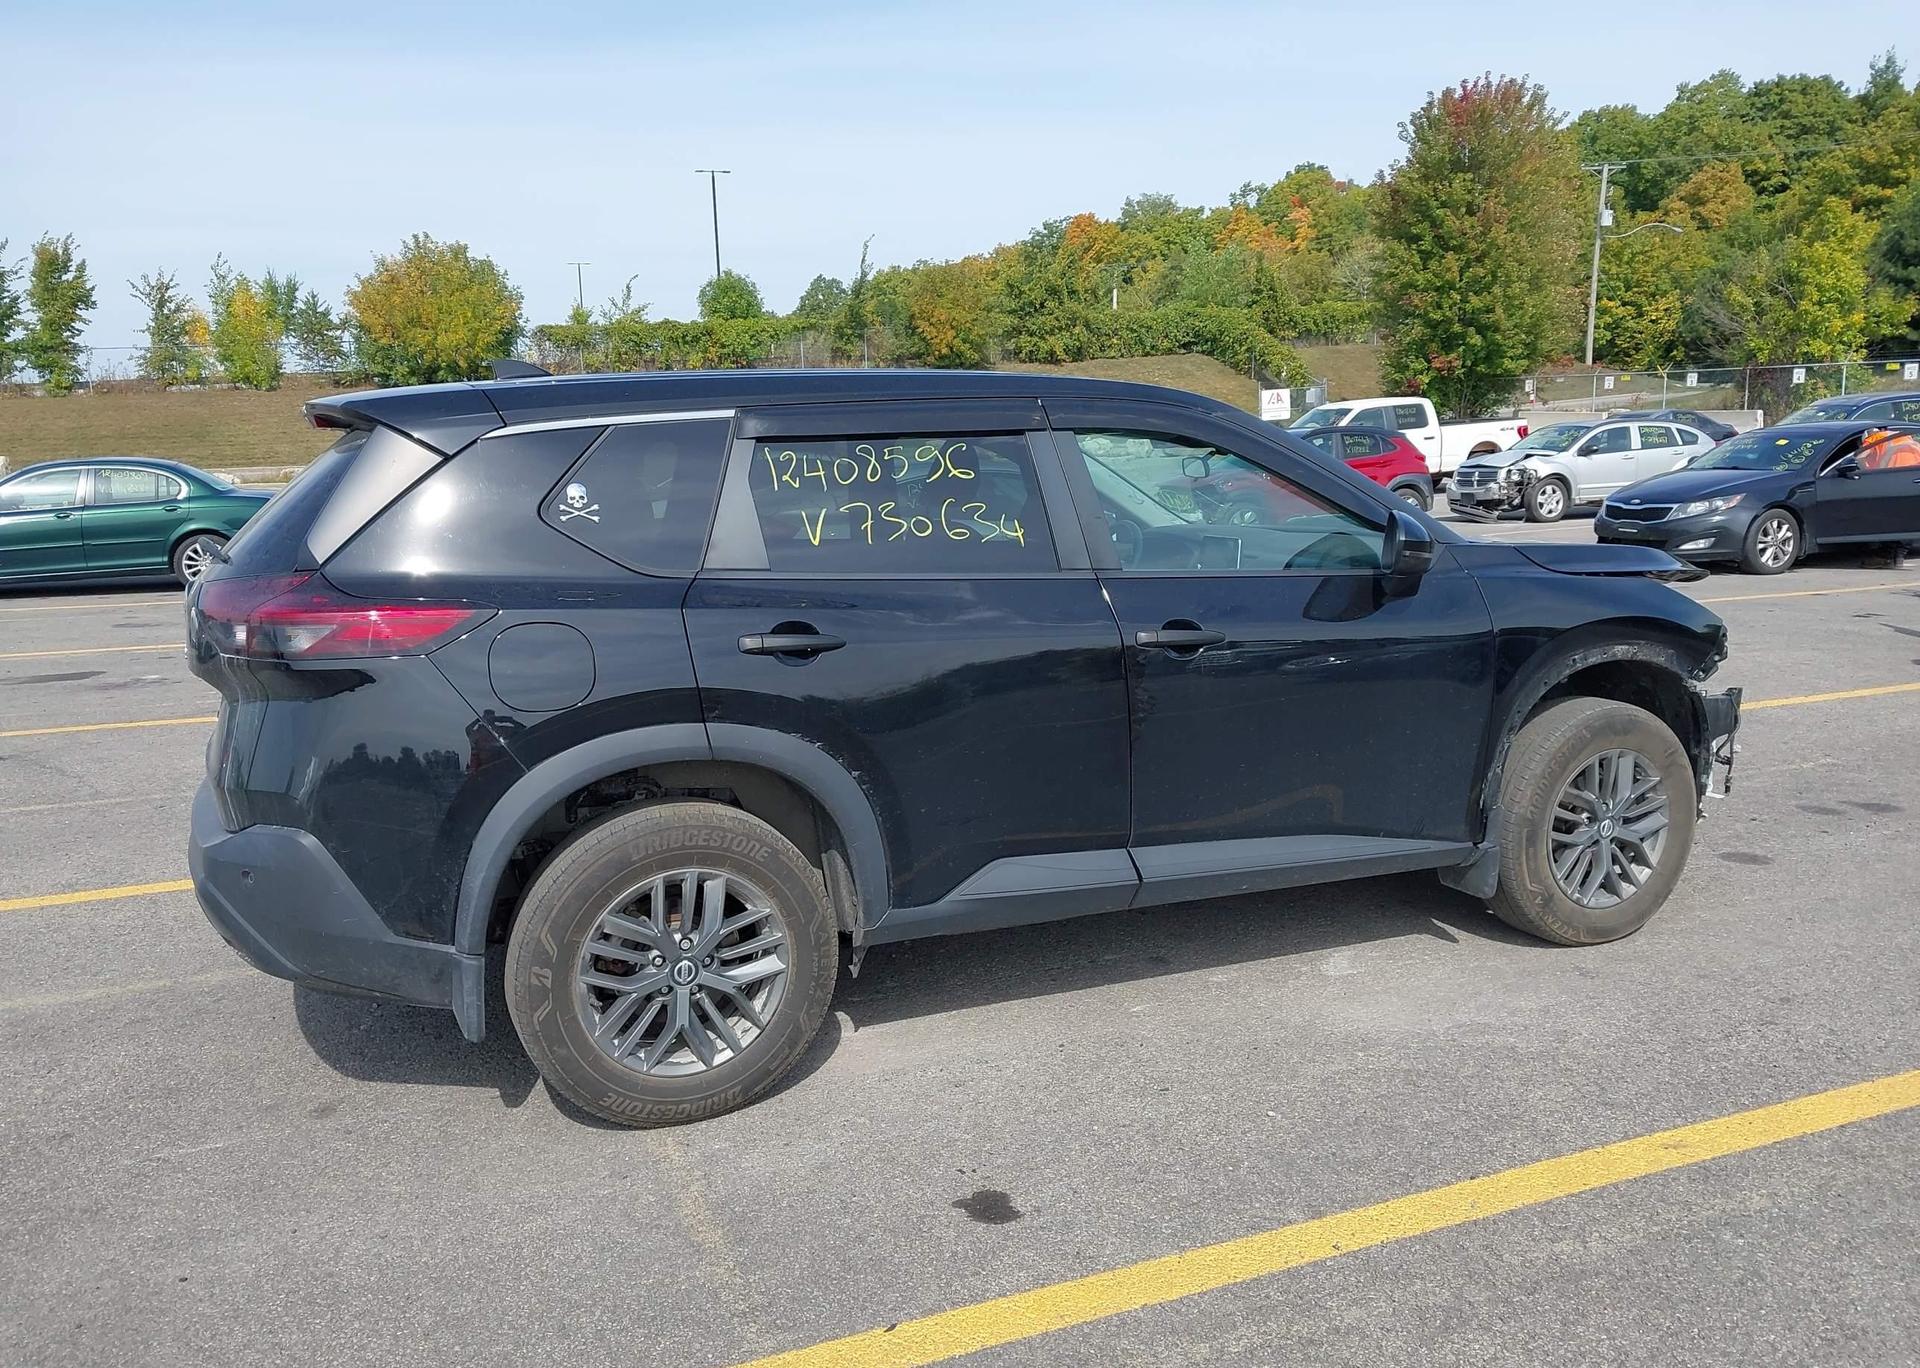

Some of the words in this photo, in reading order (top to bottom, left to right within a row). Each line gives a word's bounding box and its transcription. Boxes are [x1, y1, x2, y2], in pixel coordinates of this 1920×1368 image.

[764, 444, 975, 492] 12408596
[840, 498, 1025, 547] 730634
[630, 829, 772, 862] BRIDGESTONE
[599, 1085, 743, 1119] BRIDGESTONE
